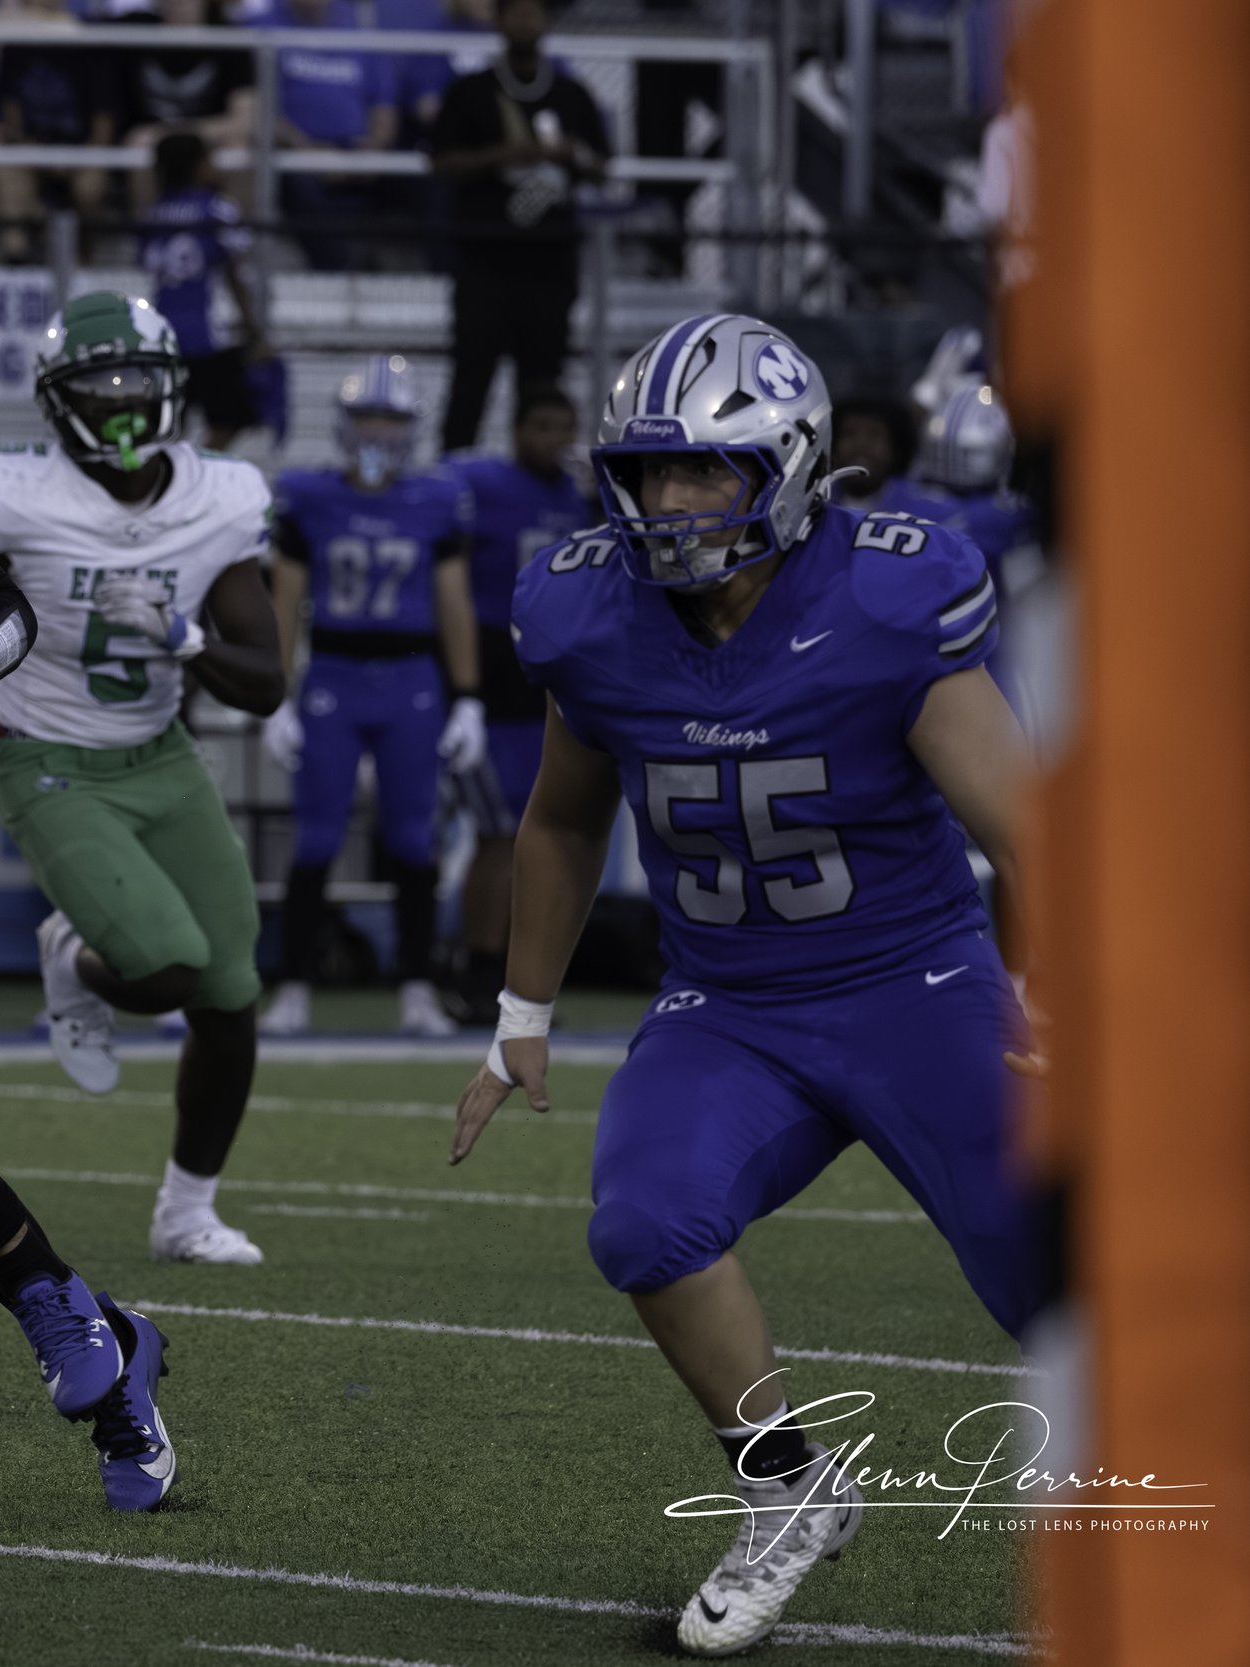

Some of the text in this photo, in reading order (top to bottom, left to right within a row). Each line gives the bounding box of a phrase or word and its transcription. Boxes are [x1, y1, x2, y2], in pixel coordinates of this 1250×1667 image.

[758, 343, 809, 400] M
[682, 720, 770, 750] Vikings
[643, 754, 857, 926] 55
